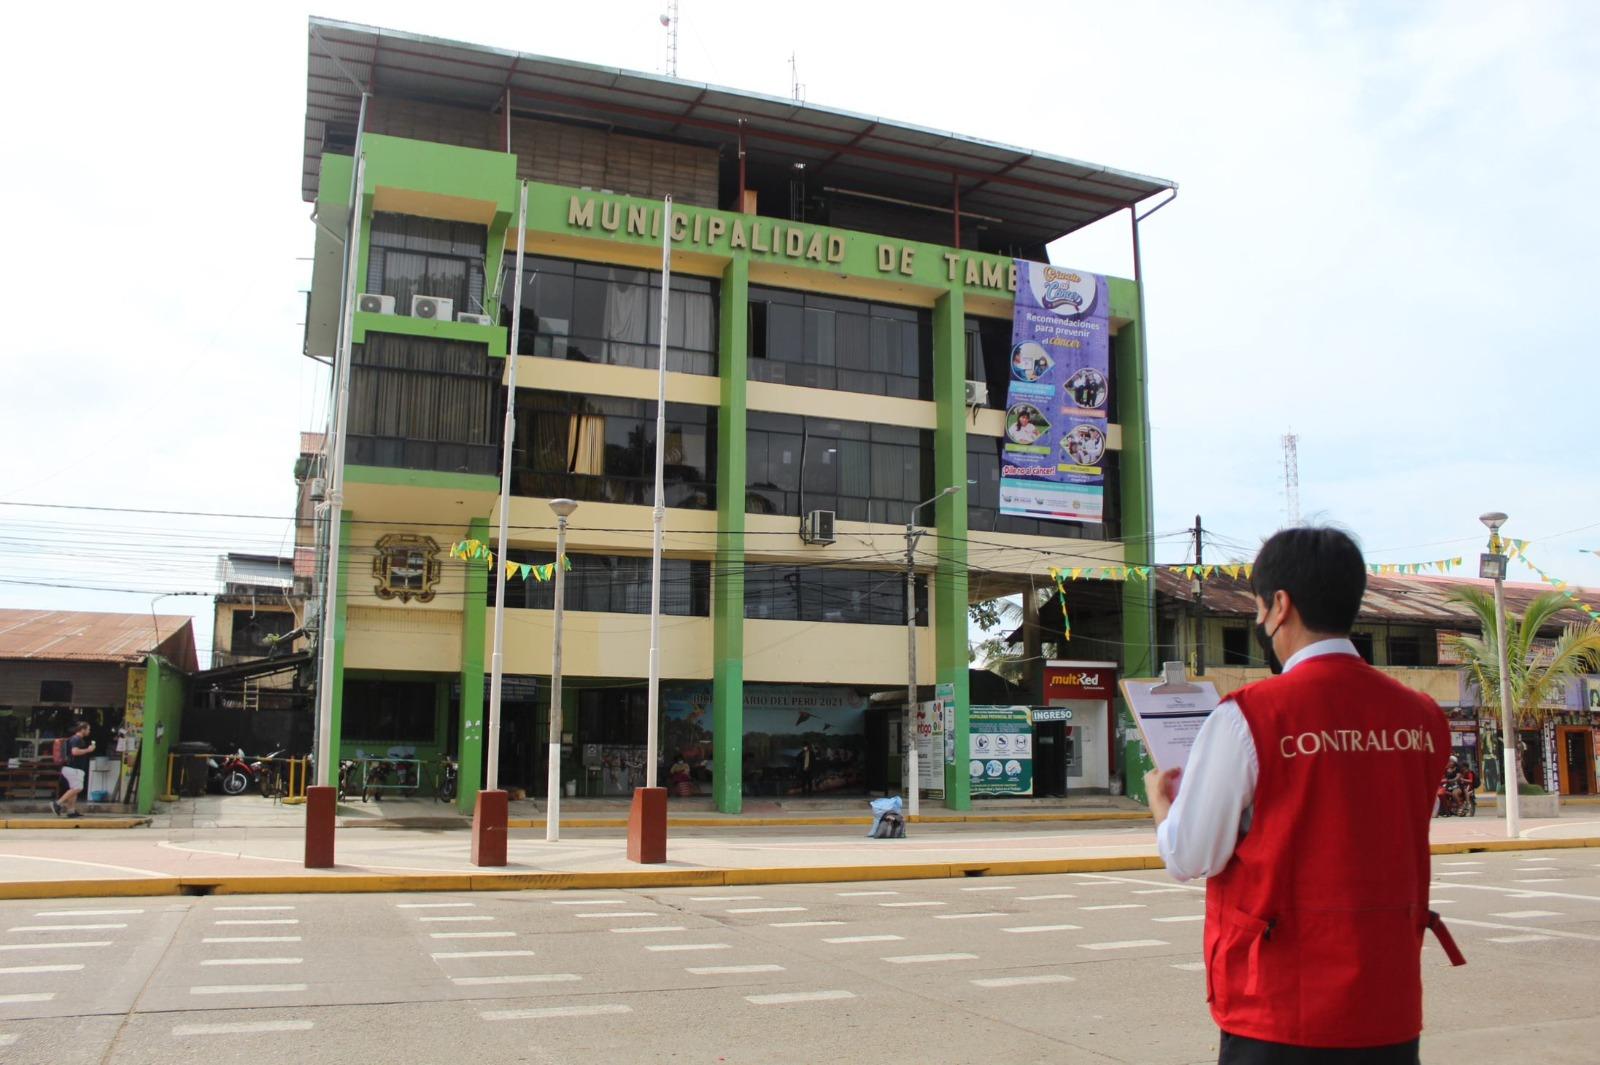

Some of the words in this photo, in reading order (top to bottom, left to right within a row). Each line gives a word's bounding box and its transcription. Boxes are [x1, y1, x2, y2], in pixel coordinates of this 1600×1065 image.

[568, 195, 846, 264] MUNICIPALIDAD
[877, 243, 916, 275] DE
[1026, 312, 1100, 330] Recomendaciones
[1035, 324, 1053, 333] para
[1056, 326, 1090, 338] prevenir
[770, 695, 790, 706] DEL
[1033, 710, 1073, 720] INGRESO
[1279, 724, 1436, 758] CONTRALORÍA
